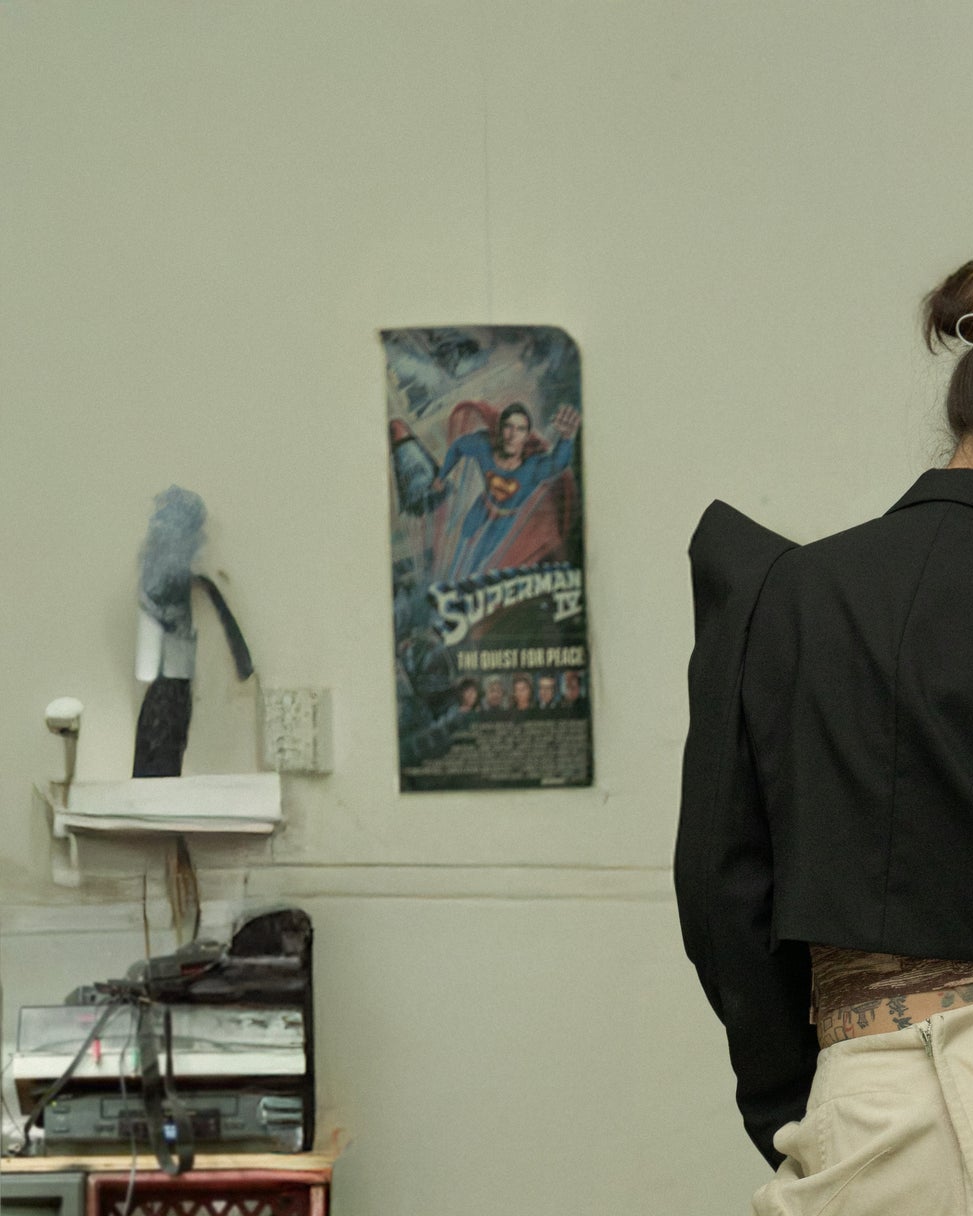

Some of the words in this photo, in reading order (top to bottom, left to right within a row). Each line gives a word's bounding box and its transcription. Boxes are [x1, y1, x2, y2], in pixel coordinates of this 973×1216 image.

[429, 568, 582, 646] SUPERMAN
[553, 590, 582, 622] IV
[458, 650, 478, 670] THE
[480, 649, 518, 670] QUEST
[521, 648, 544, 668] FOR
[546, 646, 584, 667] PEACE
